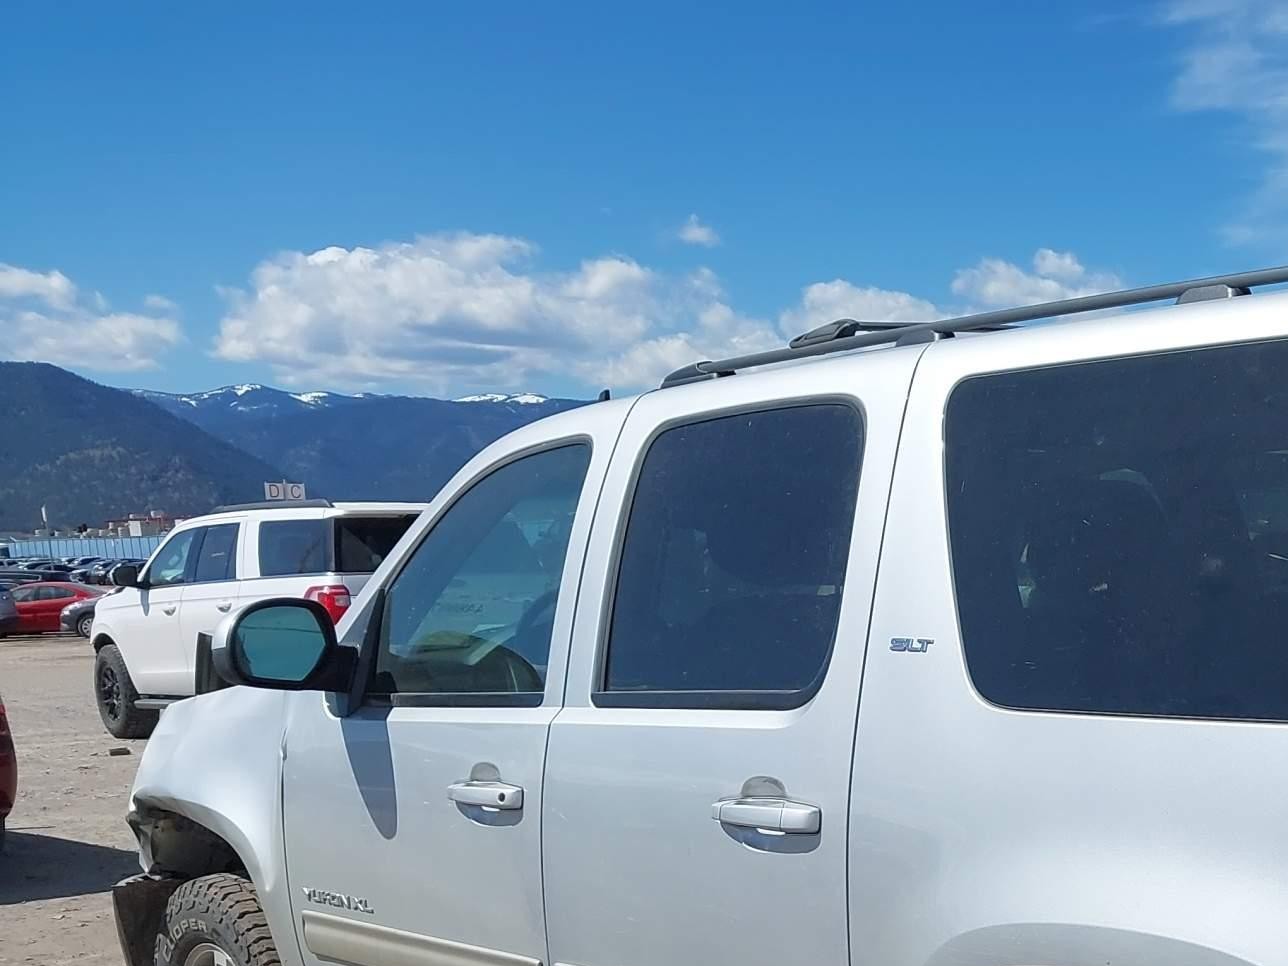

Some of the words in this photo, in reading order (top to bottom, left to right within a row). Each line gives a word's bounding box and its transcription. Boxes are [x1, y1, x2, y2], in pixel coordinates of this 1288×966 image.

[268, 484, 280, 498] D
[290, 484, 301, 499] C
[890, 637, 935, 653] SLT
